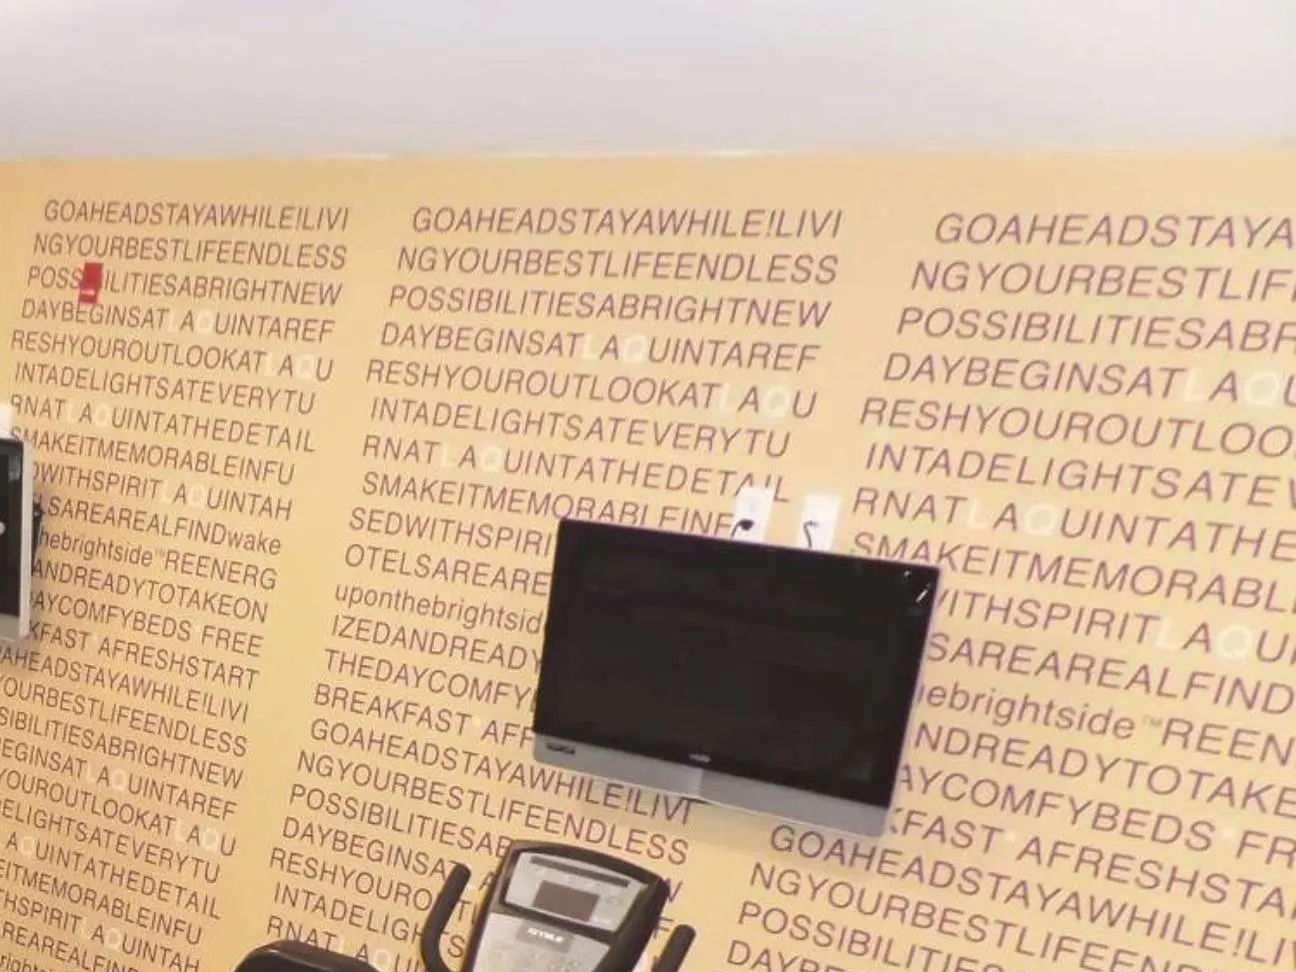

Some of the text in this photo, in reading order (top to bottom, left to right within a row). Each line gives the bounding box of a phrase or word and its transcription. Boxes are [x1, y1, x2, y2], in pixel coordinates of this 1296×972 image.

[413, 206, 842, 238] GOAHEADSTAYAWHILE!LIVI
[34, 233, 347, 270] NGYOURBESTLIFEENDLESS
[398, 246, 838, 284] NGYOURBESTLIFEENDLESS
[28, 266, 342, 307] POSSILITIESABRIGHTNEW
[388, 284, 832, 329] POSSIBILITIESABRIGHTNEW
[912, 260, 1296, 303] NGYOURBESTLIF
[14, 362, 316, 415] INTADELIGHTSATEVERYTU
[370, 397, 791, 459] INTADELIGHTSATEVERYTU
[865, 443, 1296, 509] INTADELIGHTSATE
[851, 531, 1296, 615] SMAKEITMEMORABL
[30, 588, 265, 657] AYCOMFYBEDS FREE
[97, 634, 260, 691] AFRESHSTART
[314, 683, 472, 737] BREAKFAST
[297, 750, 689, 866] NGYOURBESTLIFEENDLESS
[770, 826, 1296, 971] GOAHEADSTAYAWHILE!LI
[1016, 834, 1296, 921] AFRESHSTA
